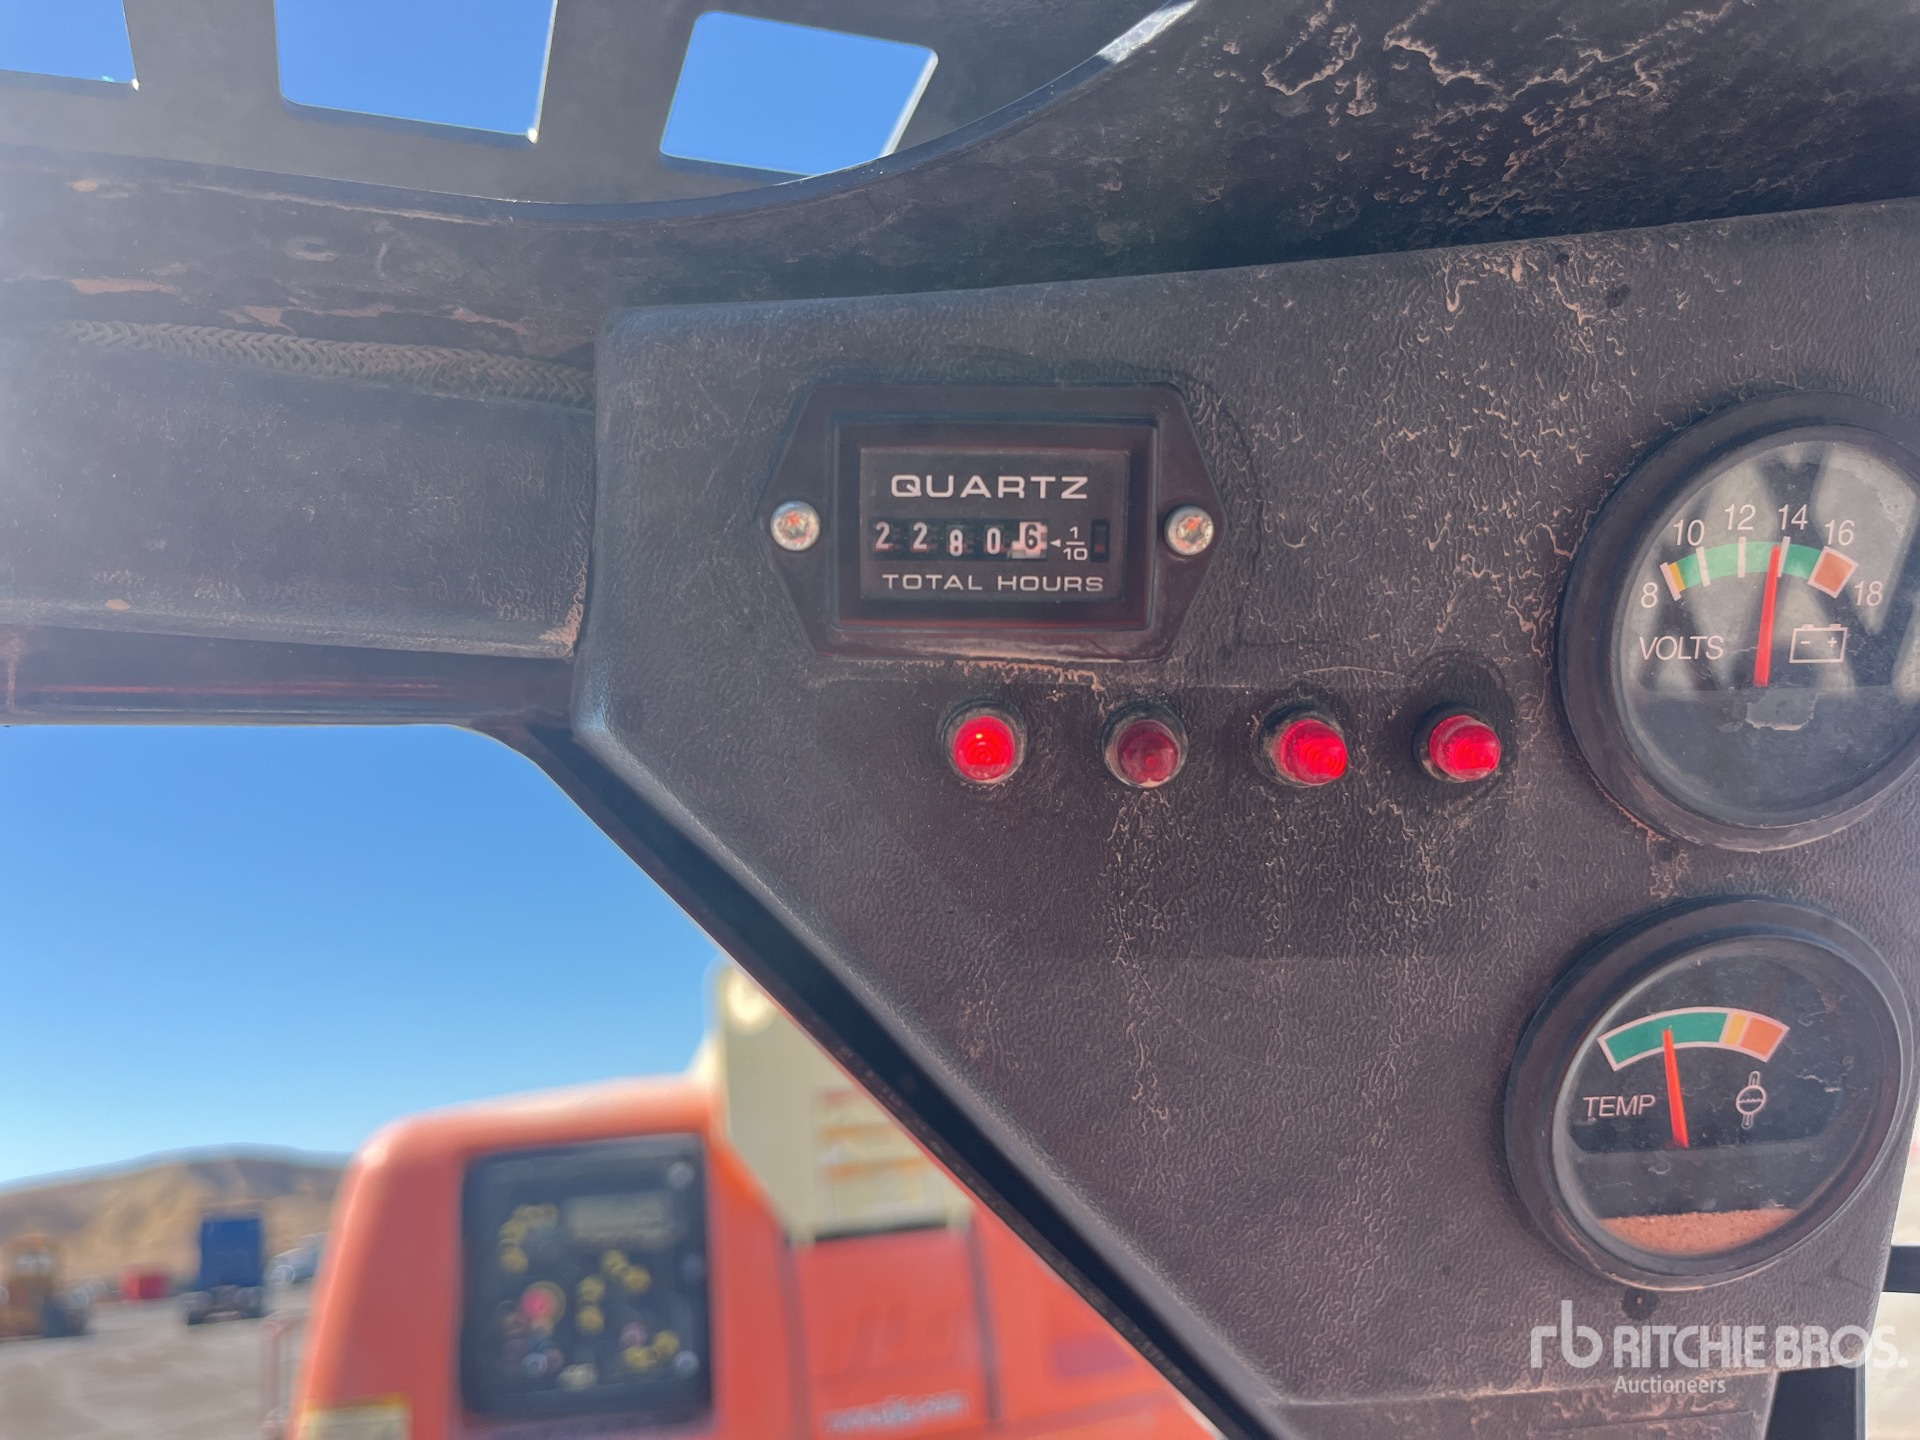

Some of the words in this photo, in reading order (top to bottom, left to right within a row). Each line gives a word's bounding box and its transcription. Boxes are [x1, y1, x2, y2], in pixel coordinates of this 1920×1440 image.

[891, 475, 1088, 499] QUARTZ
[1724, 504, 1756, 530] 12
[1778, 504, 1808, 530] 14
[1673, 520, 1705, 546] 10
[1824, 520, 1855, 545] 16
[882, 574, 982, 591] TOTAL
[998, 576, 1104, 592] HOURS
[1640, 582, 1658, 608] 8
[1854, 581, 1883, 606] 18
[1640, 635, 1725, 660] VOLTS
[1583, 1094, 1656, 1117] TEMP
